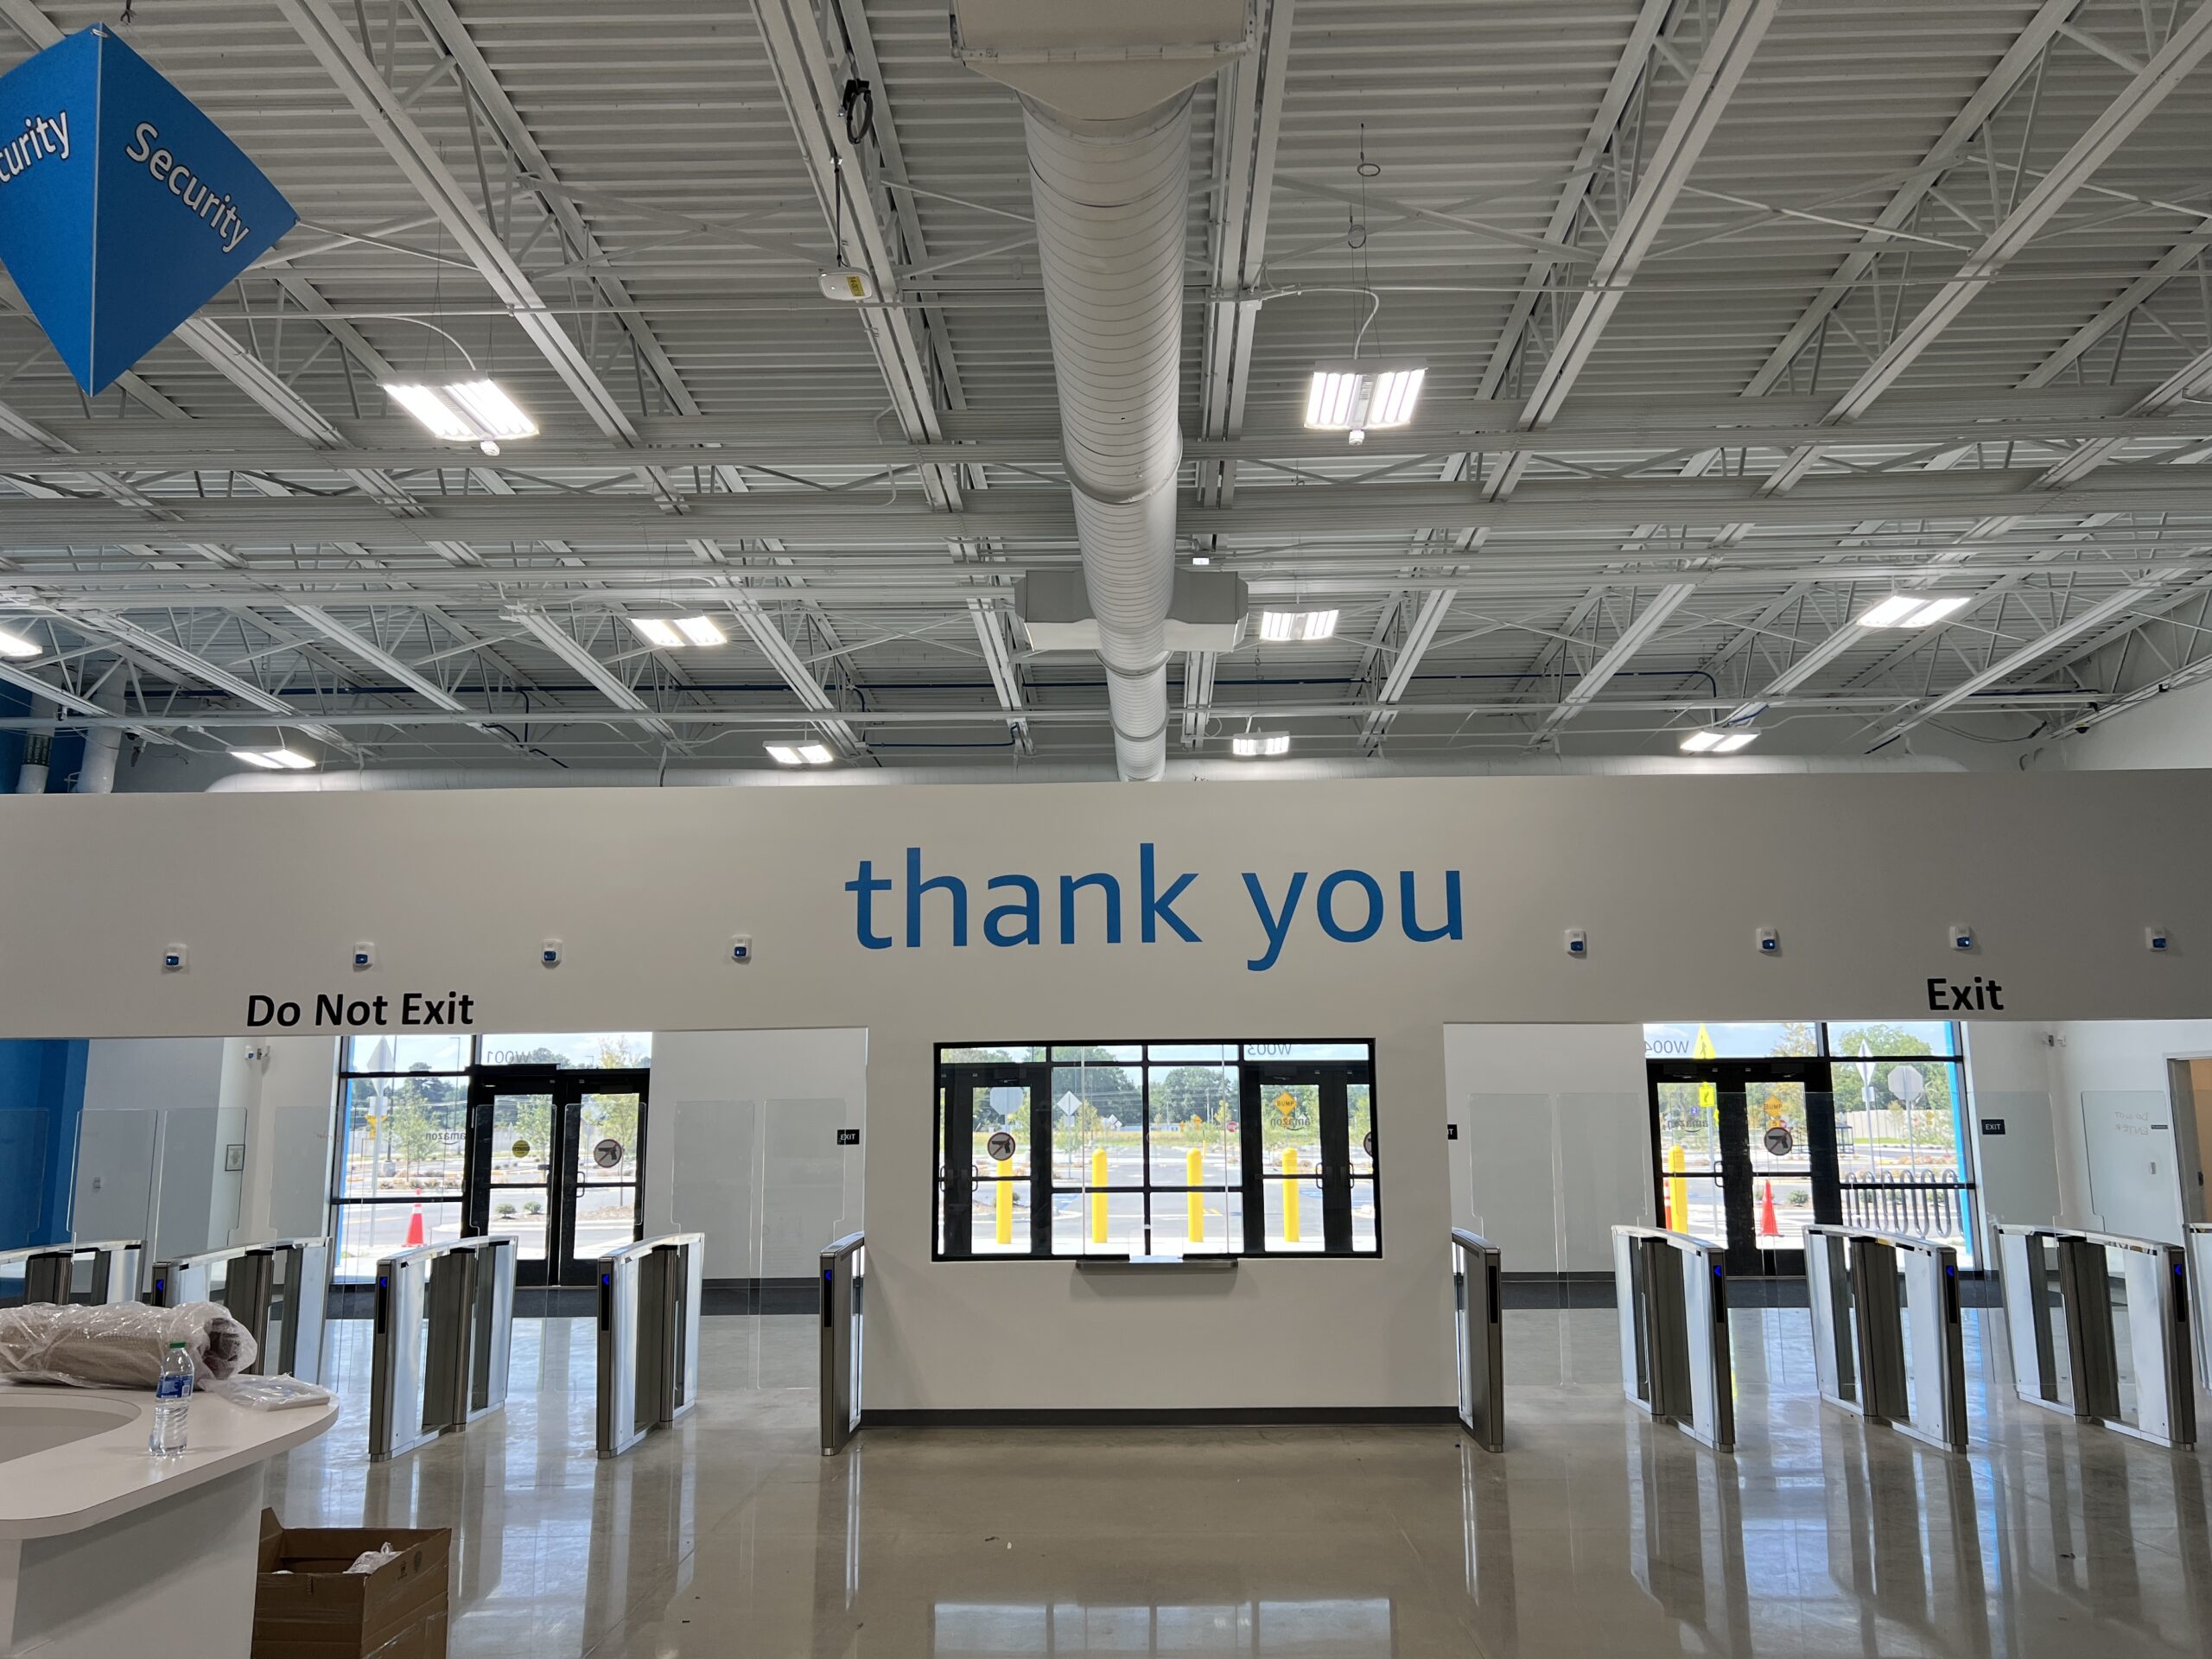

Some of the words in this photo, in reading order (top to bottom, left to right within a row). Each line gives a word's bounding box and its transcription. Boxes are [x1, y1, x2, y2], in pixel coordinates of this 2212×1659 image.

[125, 121, 250, 253] Security
[844, 842, 1203, 950] thank
[1241, 869, 1463, 972] you
[247, 995, 301, 1027] Do
[315, 994, 388, 1026] Not
[402, 991, 474, 1025] Exit
[1926, 976, 2004, 1010] Exit
